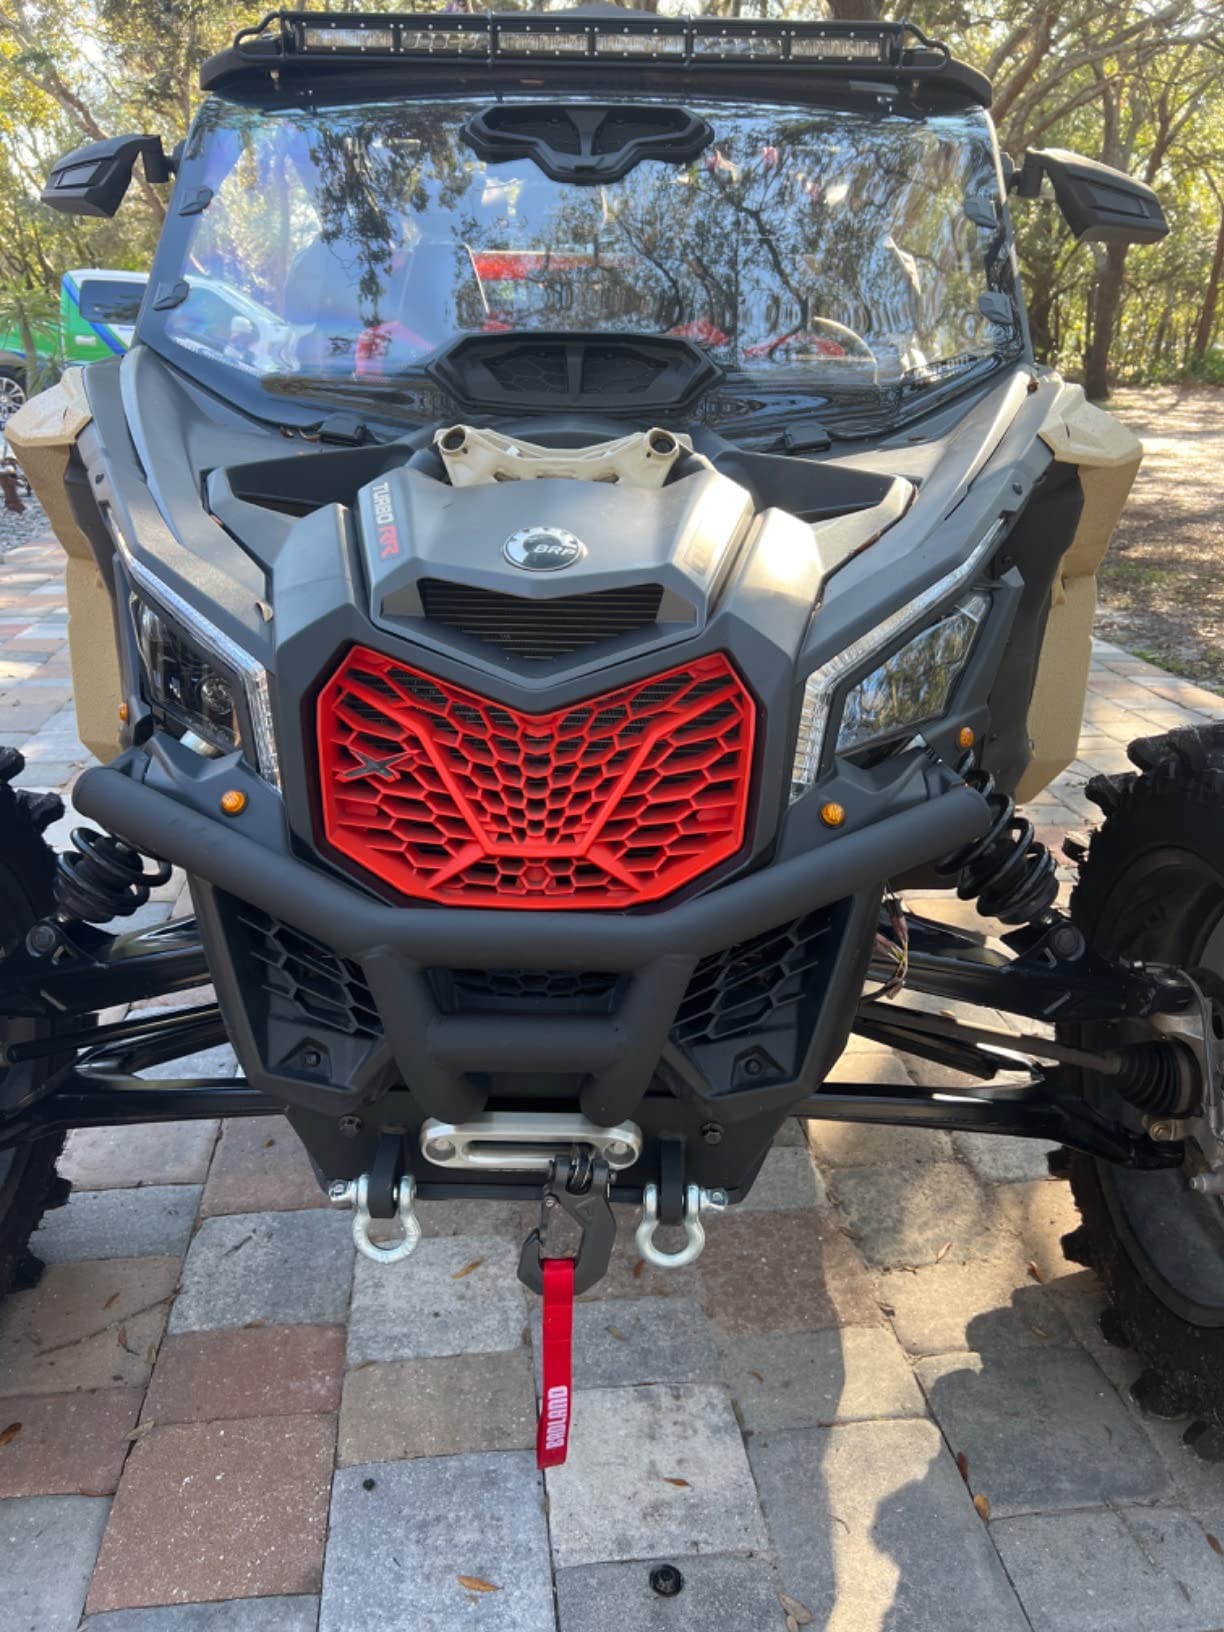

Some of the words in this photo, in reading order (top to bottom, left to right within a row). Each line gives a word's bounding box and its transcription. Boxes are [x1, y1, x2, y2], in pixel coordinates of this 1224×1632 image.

[372, 482, 394, 524] TURBO
[378, 525, 400, 559] RR
[533, 544, 576, 555] BRP
[545, 1385, 568, 1450] BADLAND
